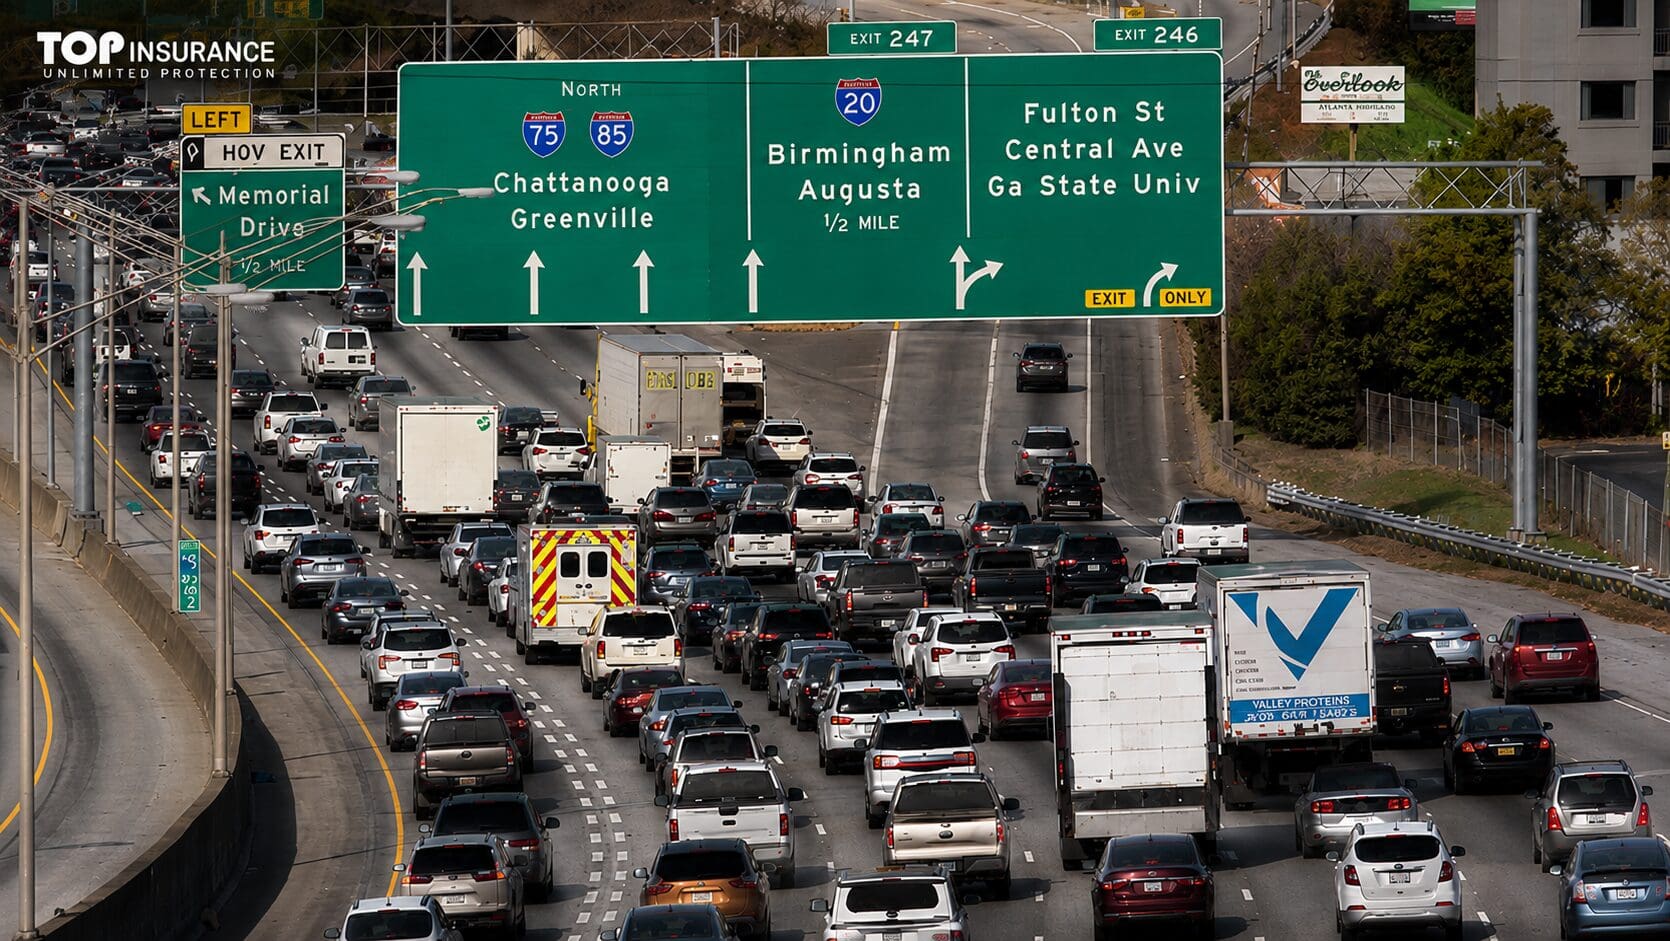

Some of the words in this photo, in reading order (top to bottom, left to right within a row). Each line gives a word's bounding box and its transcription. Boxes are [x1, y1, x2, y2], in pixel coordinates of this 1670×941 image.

[850, 32, 882, 45] EXIT
[890, 30, 934, 48] 247
[1116, 28, 1147, 41] EXIT
[1154, 26, 1199, 44] 246
[561, 81, 621, 97] NORTH
[844, 92, 876, 115] 20
[1024, 102, 1117, 124] Fulton
[1135, 101, 1165, 122] St
[191, 110, 242, 129] LEFT
[529, 124, 559, 146] 75
[597, 124, 627, 146] 85
[223, 144, 266, 161] HOV
[280, 143, 325, 161] EXIT
[768, 142, 950, 169] Birmingham
[1005, 138, 1113, 161] Central
[1132, 137, 1184, 159] Ave
[219, 184, 329, 205] Memorial
[493, 172, 669, 198] Chattanooga
[798, 178, 921, 206] Augusta
[988, 175, 1022, 197] Ga
[1039, 174, 1117, 196] State
[1134, 173, 1201, 195] Univ
[240, 216, 304, 237] Drive
[511, 206, 654, 230] Greenville
[824, 212, 848, 233] 1/2
[858, 214, 900, 231] MILE
[270, 258, 306, 272] MILE
[1091, 292, 1127, 307] EXIT
[1164, 290, 1207, 306] ONLY
[1252, 699, 1292, 710] VALLEY
[1294, 695, 1350, 708] PROTEINS
